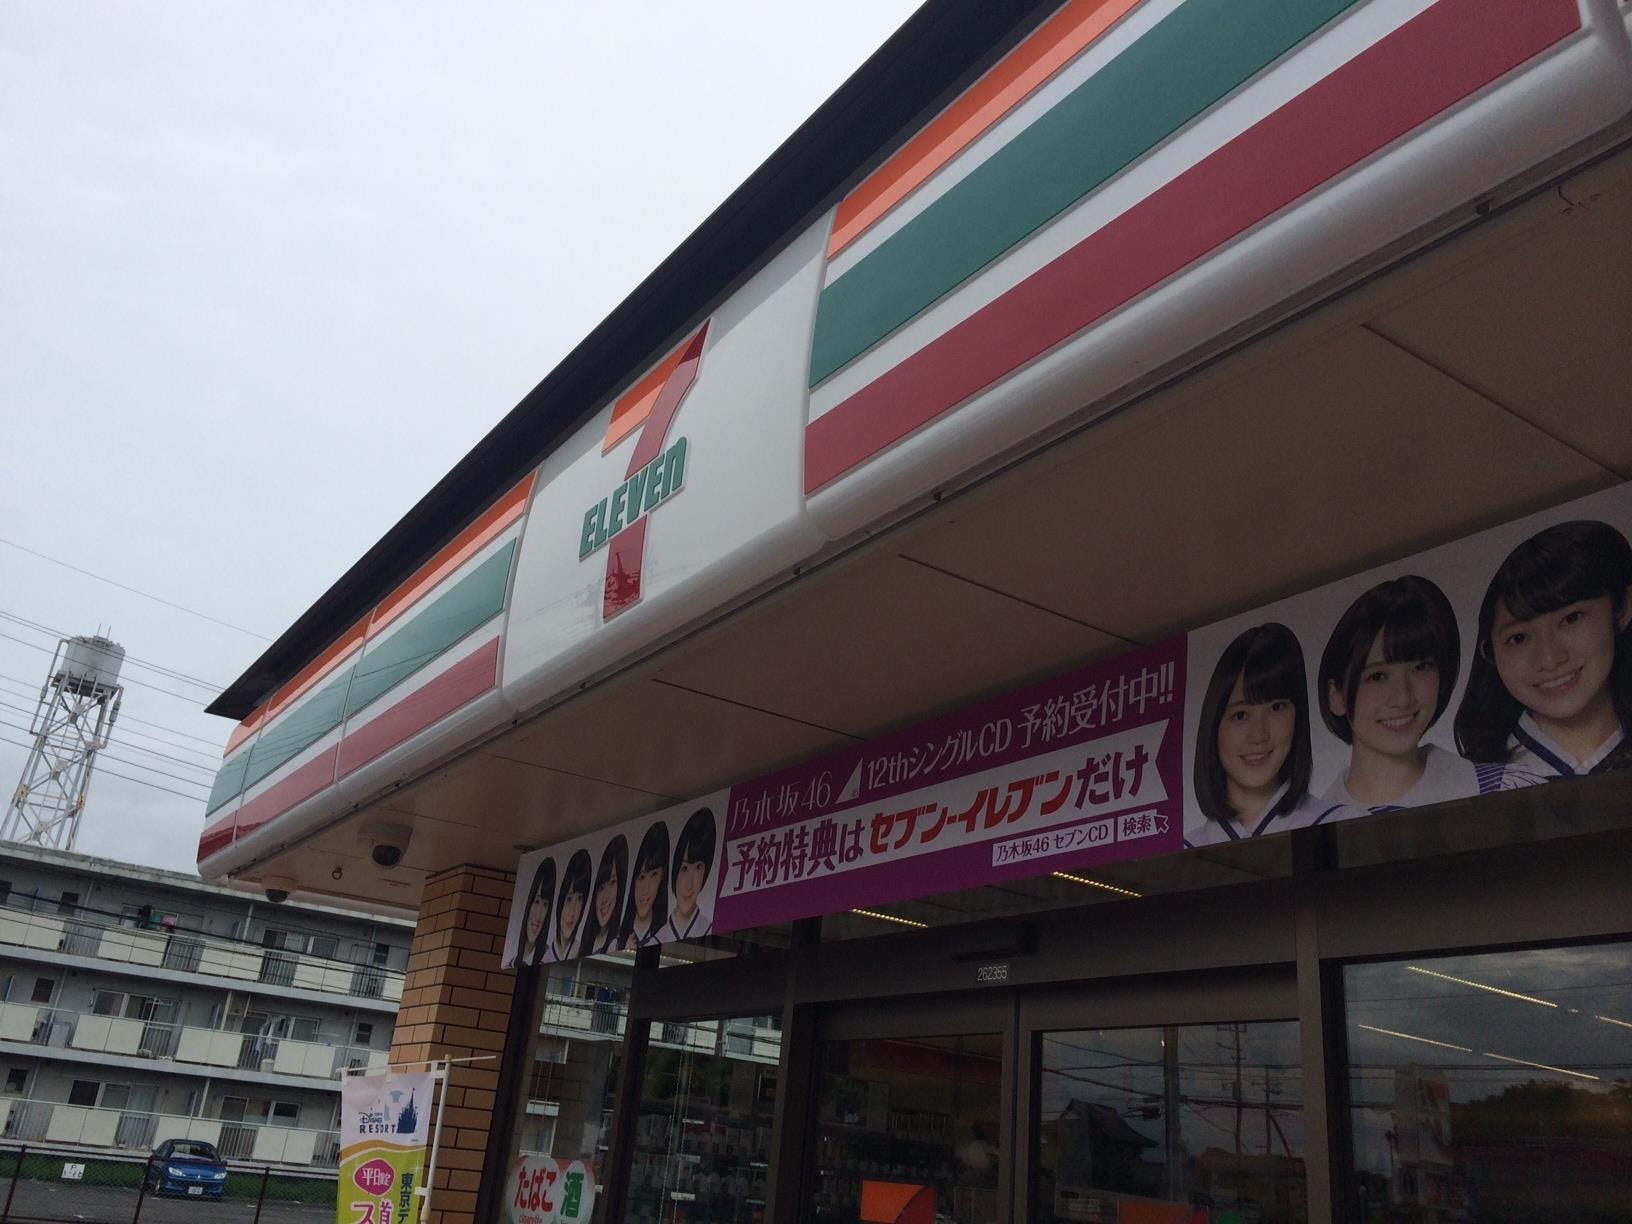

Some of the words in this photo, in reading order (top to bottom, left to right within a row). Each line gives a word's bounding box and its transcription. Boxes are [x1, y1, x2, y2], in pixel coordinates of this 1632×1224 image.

[601, 317, 711, 621] 7
[730, 771, 832, 833] 乃木坂46
[867, 719, 1012, 790] 12thシングルCD
[996, 837, 1050, 862] 乃木坂46
[1053, 824, 1109, 849] セブンCD
[1122, 815, 1152, 837] 検索
[359, 1124, 397, 1134] RESORT
[514, 1166, 557, 1212] たばこ
[560, 1171, 585, 1218] 酒
